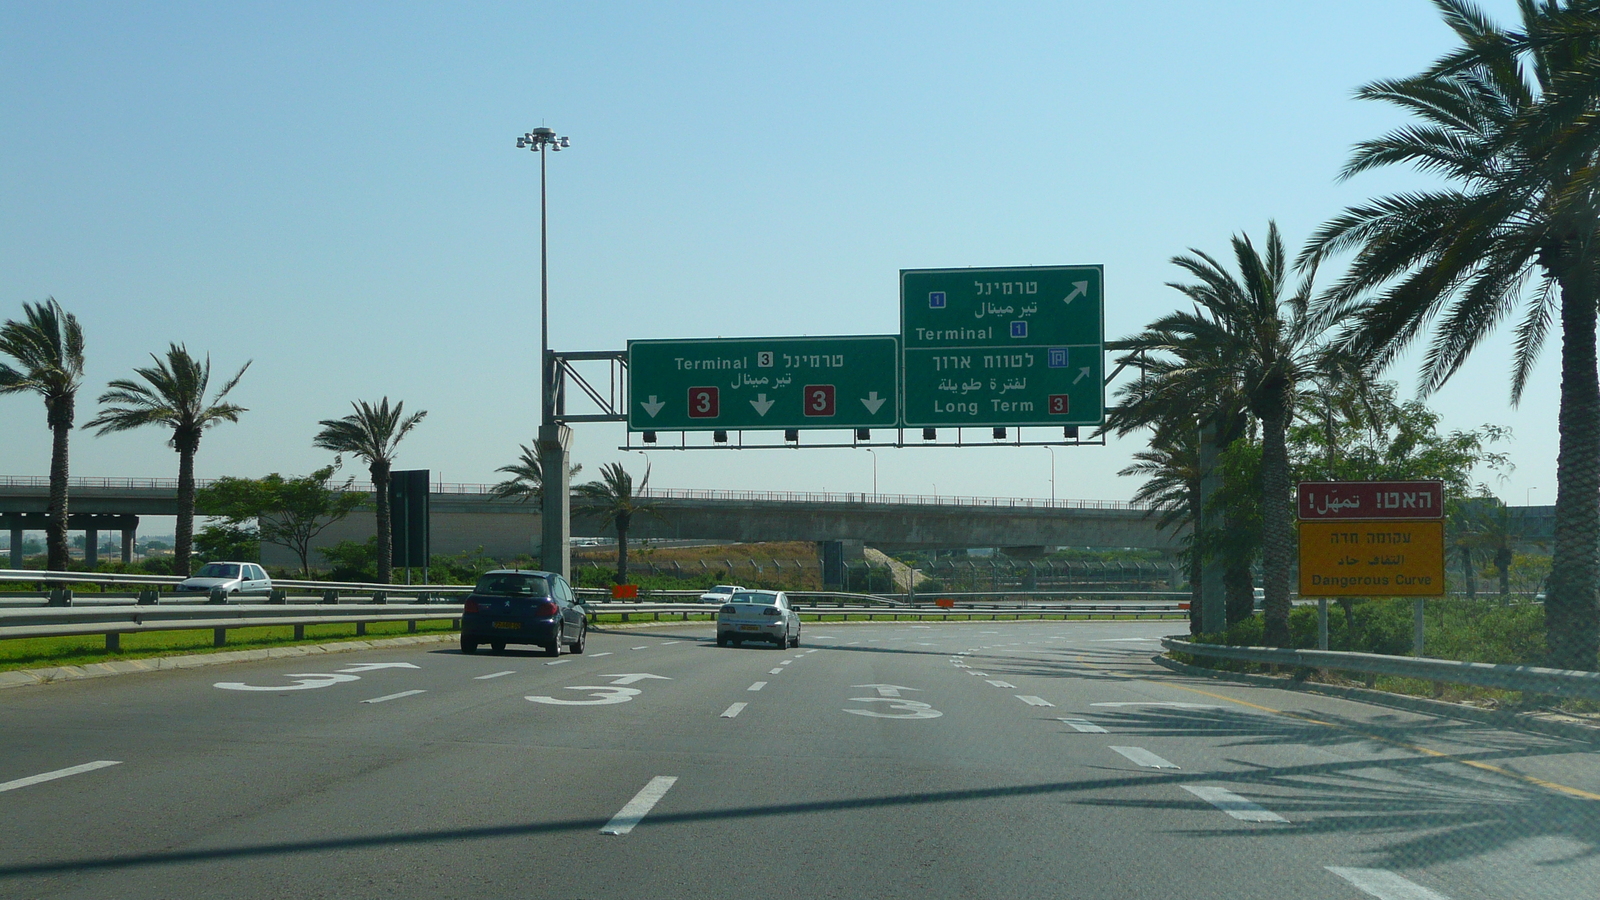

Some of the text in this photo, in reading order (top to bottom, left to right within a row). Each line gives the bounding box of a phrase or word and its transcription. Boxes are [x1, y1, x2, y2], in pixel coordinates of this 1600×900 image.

[974, 281, 1038, 295] טרמינל
[915, 326, 993, 340] Terminal
[674, 353, 770, 370] Terminal 3
[783, 354, 844, 368] טרמינל
[932, 353, 1034, 371] לטווח ארוך
[696, 392, 711, 413] 3
[812, 390, 827, 411] 3
[934, 399, 1034, 415] Long Term
[1054, 397, 1064, 411] 3
[1376, 492, 1432, 508] האט!
[1330, 532, 1411, 545] עקומה חדה
[1312, 574, 1432, 588] Dangerous Curve
[213, 673, 362, 691] 3
[524, 685, 642, 706] 3
[841, 697, 943, 720] 3
